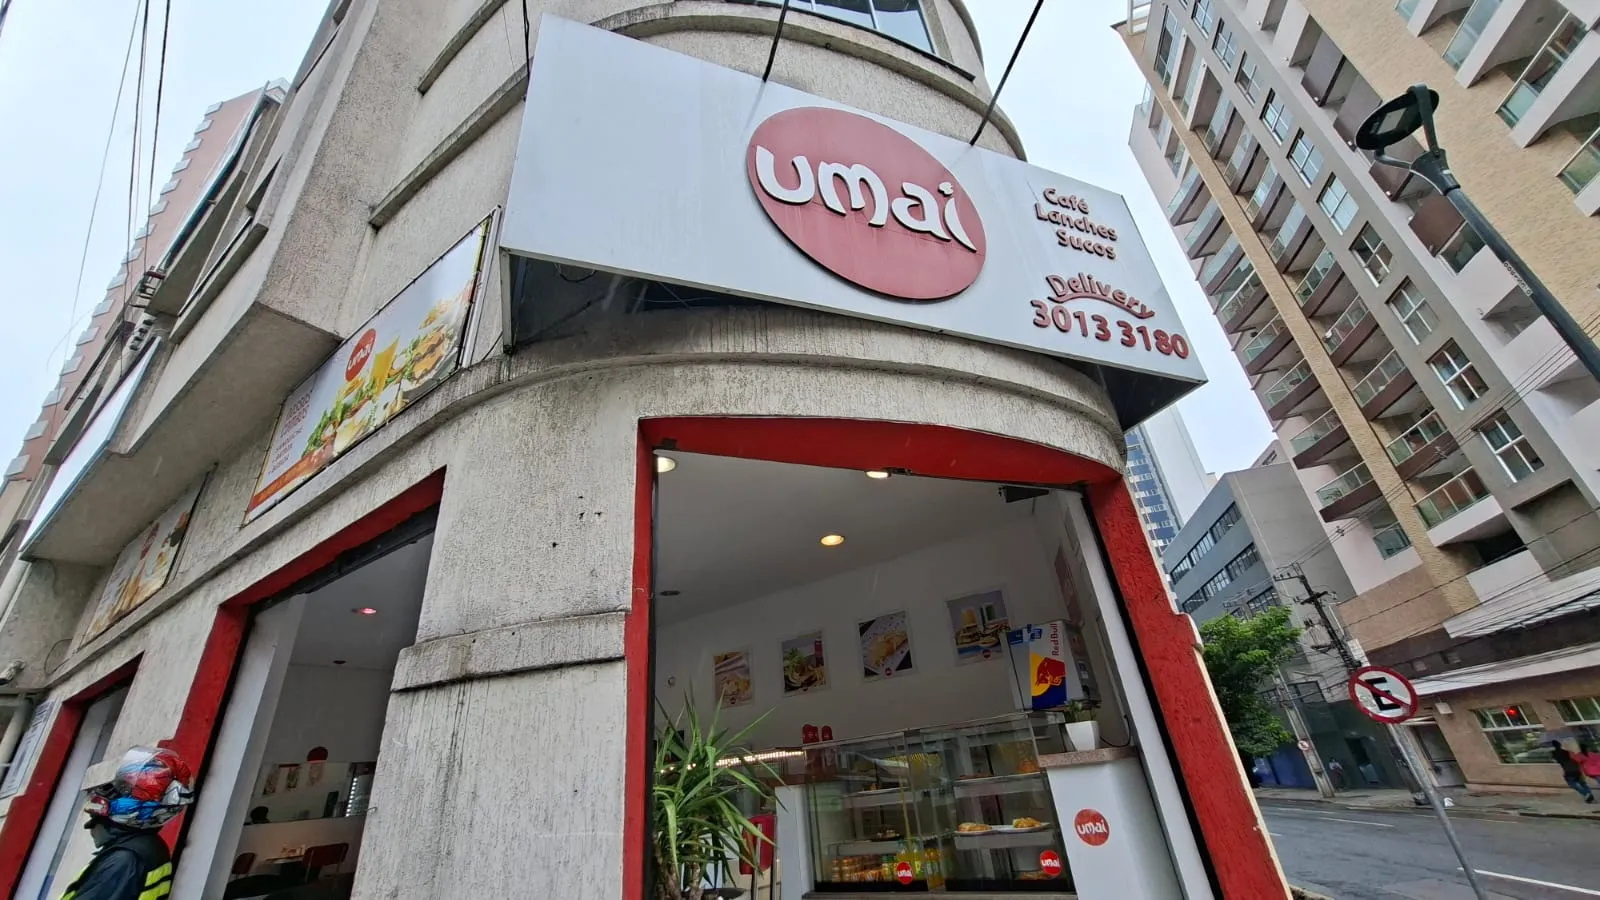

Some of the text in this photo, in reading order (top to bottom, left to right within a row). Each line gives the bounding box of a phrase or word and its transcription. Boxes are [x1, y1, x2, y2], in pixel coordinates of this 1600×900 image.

[755, 145, 976, 253] umai
[1043, 187, 1089, 215] Café
[1034, 202, 1118, 242] Lanches
[1056, 229, 1116, 260] Sucos
[1045, 272, 1156, 320] Delivery
[1030, 299, 1190, 360] 3013 3180
[1364, 676, 1401, 711] E
[1077, 819, 1108, 835] umai
